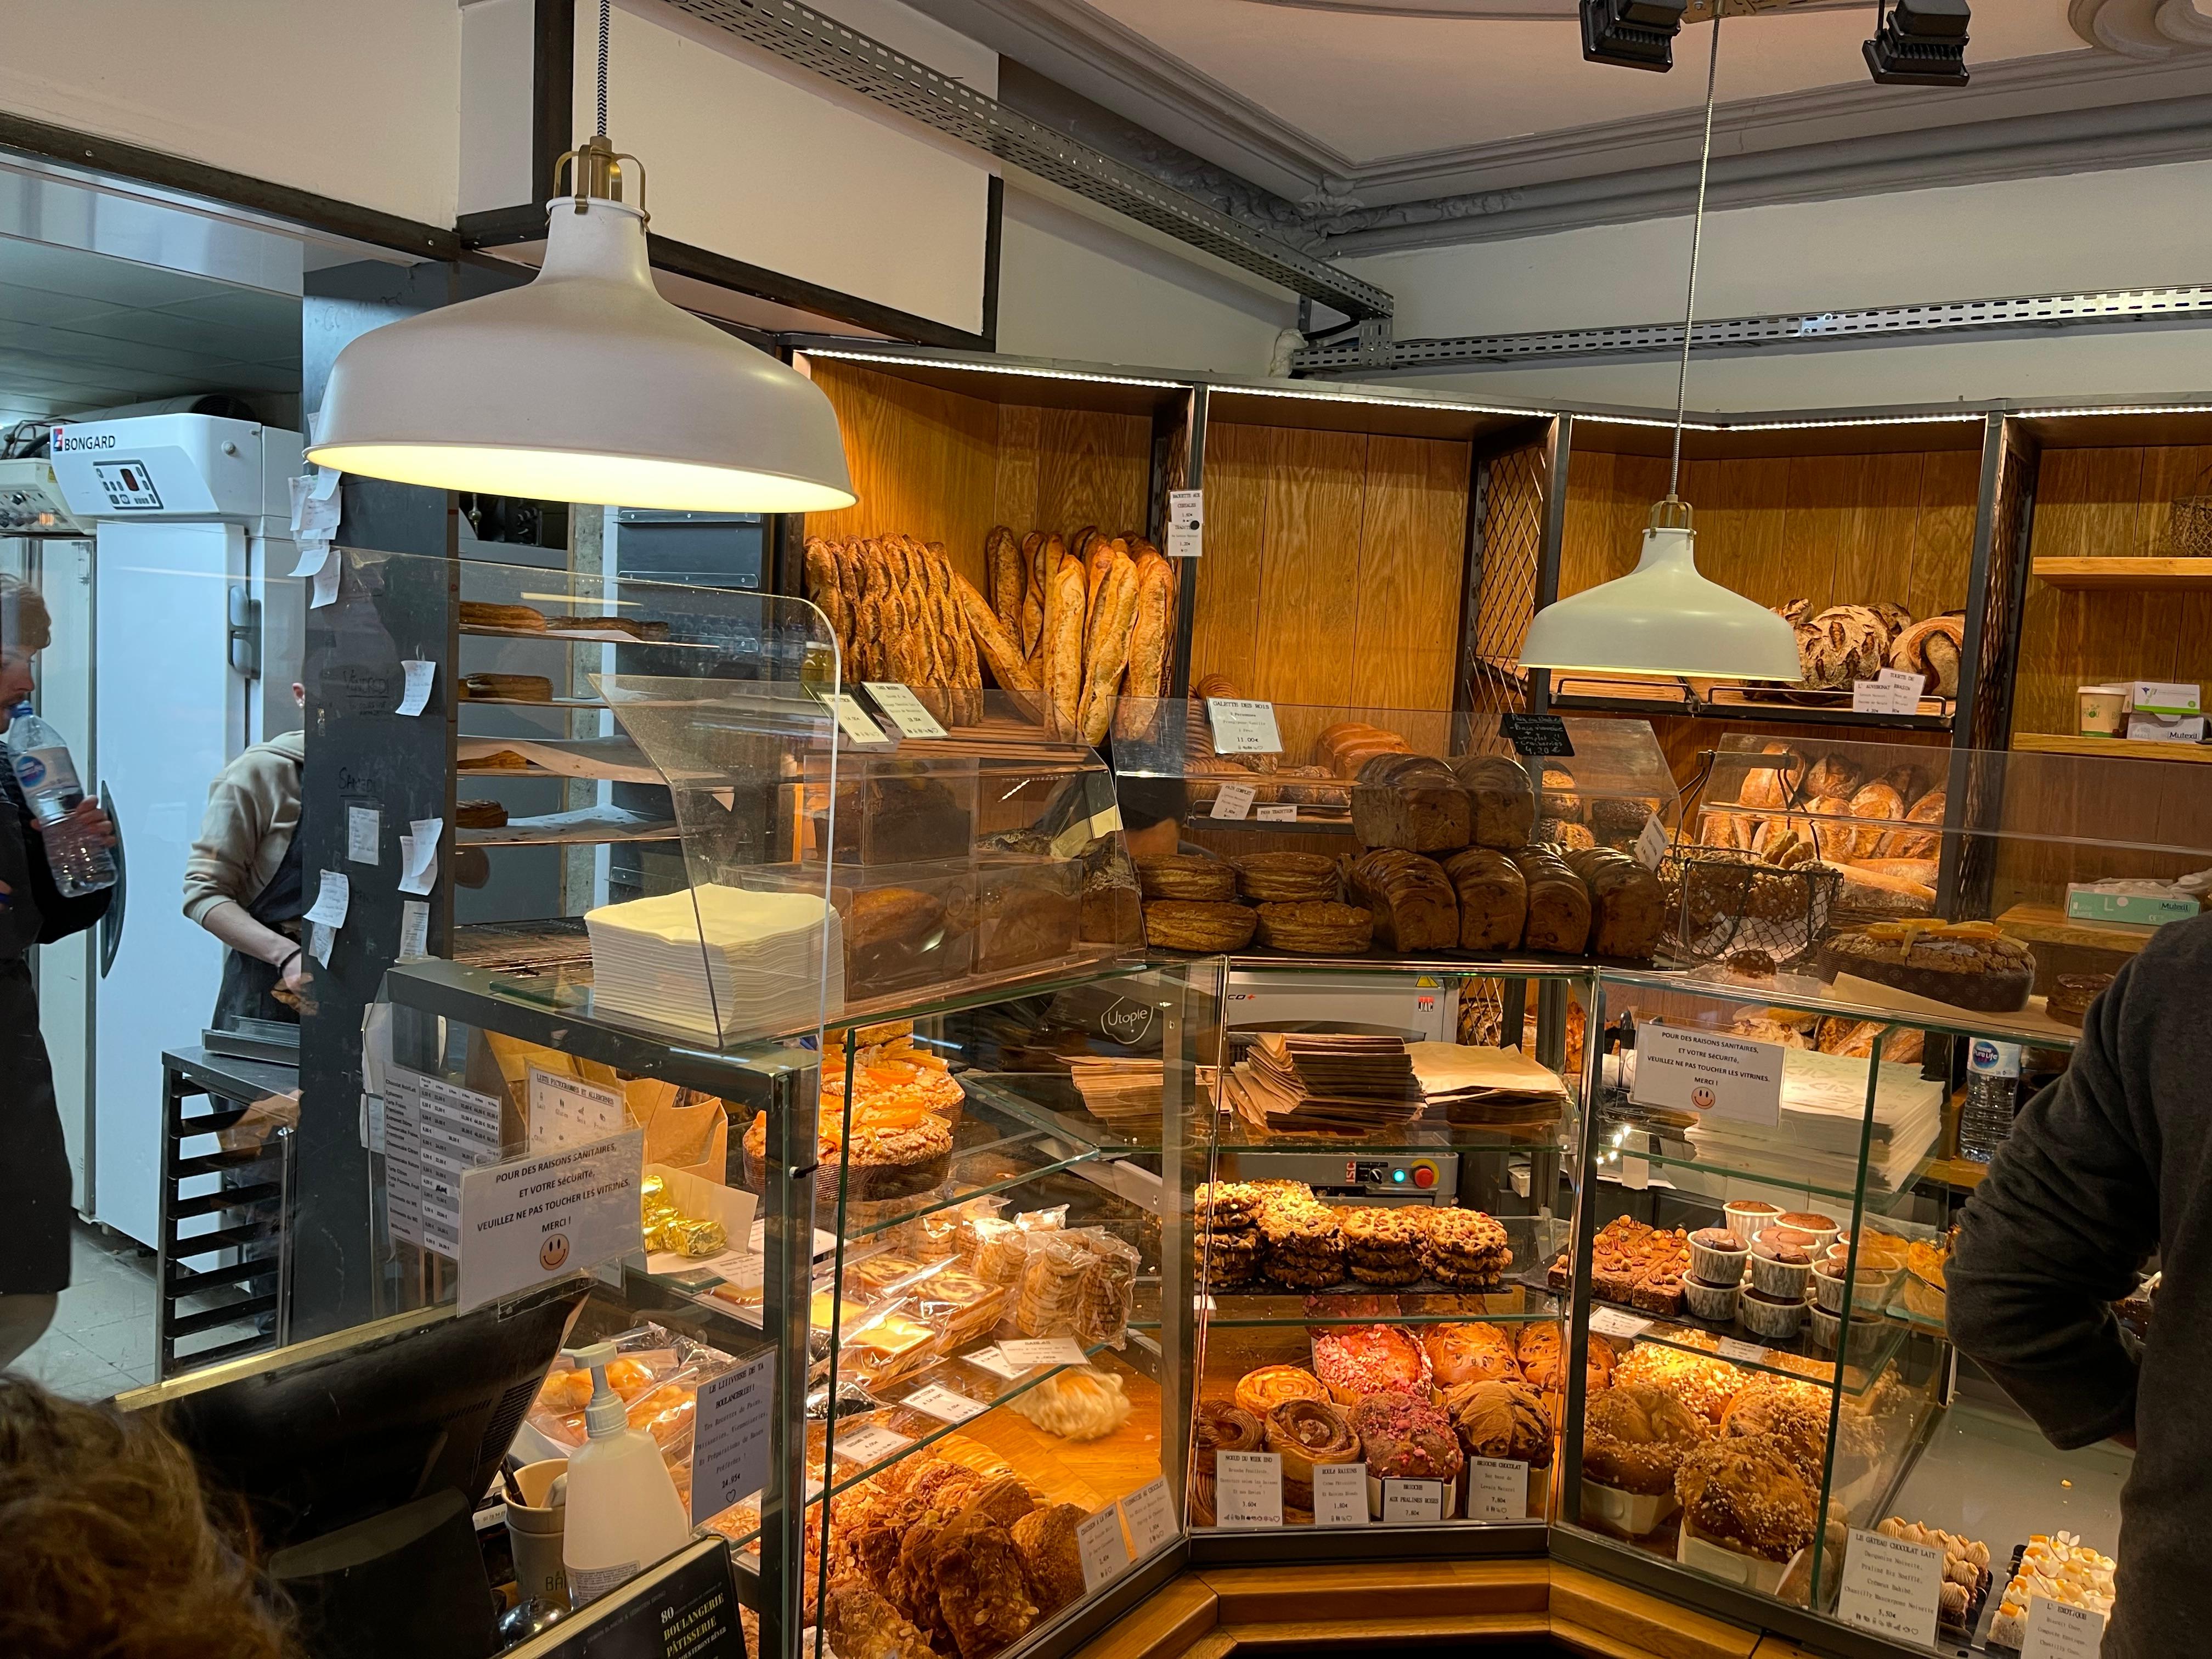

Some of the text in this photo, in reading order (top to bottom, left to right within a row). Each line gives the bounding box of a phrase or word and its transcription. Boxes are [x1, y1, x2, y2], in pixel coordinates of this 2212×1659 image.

[65, 436, 115, 450] BONGARD
[2104, 898, 2114, 911] L
[1418, 1001, 1434, 1012] JAC
[1687, 1049, 1706, 1058] VOTRE
[1693, 1037, 1720, 1047] RAISONS
[1721, 1042, 1759, 1054] SANITAIRES,
[1647, 1056, 1674, 1065] VEUILLEZ
[1697, 1064, 1727, 1074] TOUCHER
[1986, 1053, 1997, 1061] Life
[1694, 1077, 1714, 1085] MERCI
[496, 1143, 617, 1183] POUR DES RAISONS SANITAIRES,
[519, 1188, 527, 1198] ET
[531, 1180, 556, 1194] VOTRE
[477, 1178, 630, 1232] VEUILLEZ NE PAS TOUCHER LES VITRINES.
[542, 1218, 566, 1233] MERCI
[709, 1384, 716, 1394] LE
[748, 1366, 755, 1376] DE
[758, 1363, 764, 1371] TA
[715, 1410, 737, 1425] Recettes
[1890, 1542, 1918, 1555] CHOCOLAT
[1921, 1549, 1936, 1559] LAIT
[661, 1606, 674, 1623] 80
[664, 1592, 724, 1641] BOULANGERIE
[667, 1615, 716, 1658] PÂTISSERIE
